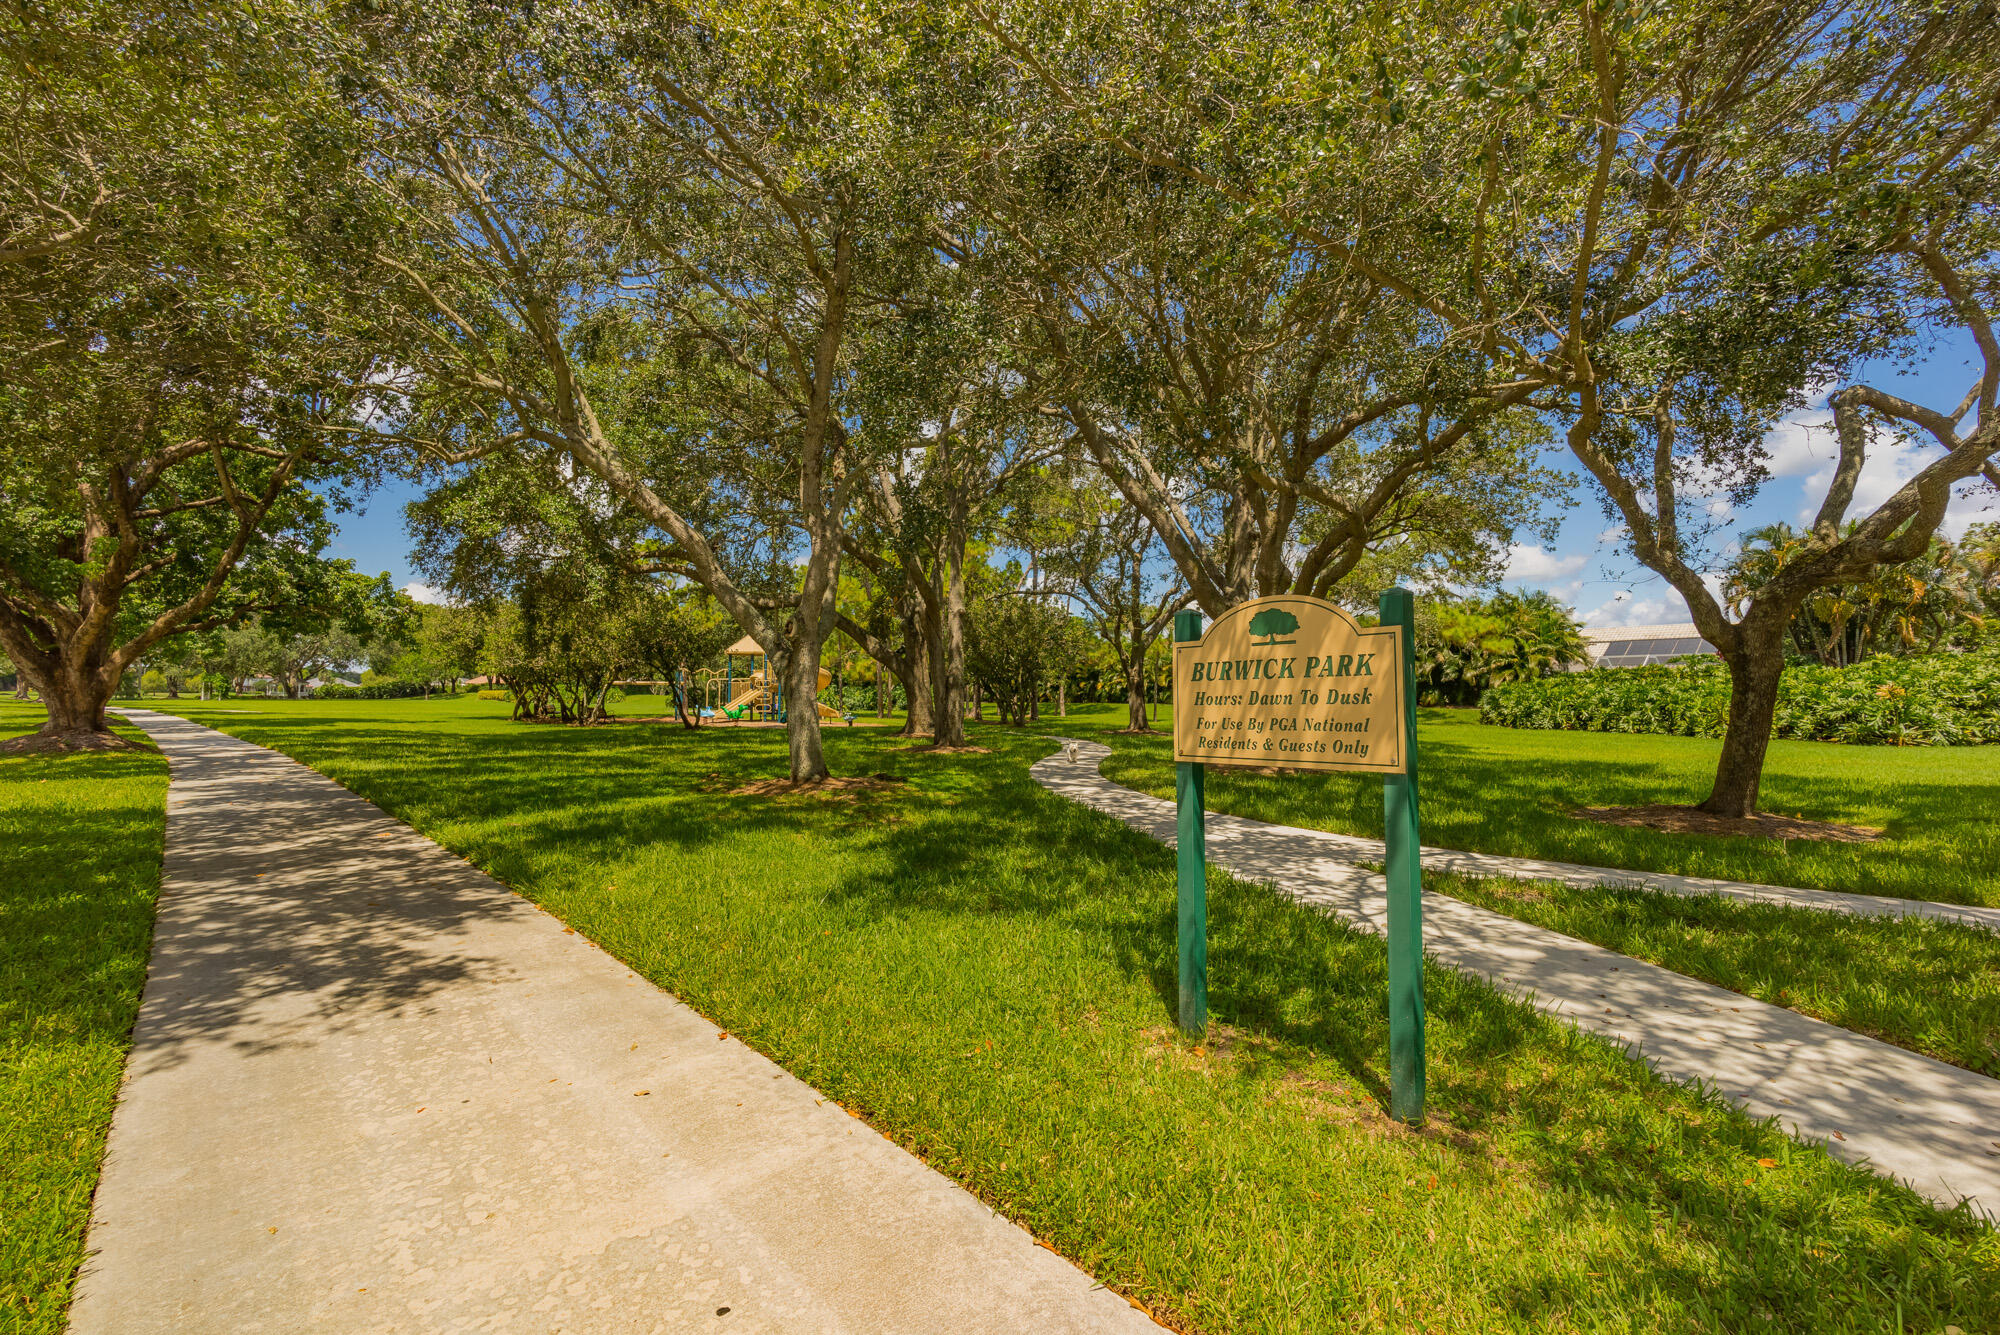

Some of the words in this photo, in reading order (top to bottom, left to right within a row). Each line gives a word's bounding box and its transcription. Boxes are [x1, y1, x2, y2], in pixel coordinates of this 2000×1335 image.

[1191, 658, 1296, 682] BURWICK
[1304, 653, 1376, 678] PARK
[1194, 692, 1242, 706] Hours:
[1248, 691, 1293, 705] Dawn
[1301, 689, 1319, 704] To
[1326, 688, 1372, 704] Dusk
[1196, 718, 1217, 730] For
[1222, 718, 1242, 730] Use
[1248, 718, 1264, 733] By
[1269, 718, 1297, 731] PGA
[1303, 718, 1370, 732] National
[1199, 737, 1257, 750] Residents
[1263, 738, 1273, 750] &
[1279, 739, 1326, 752] Guests
[1333, 740, 1369, 758] Only
